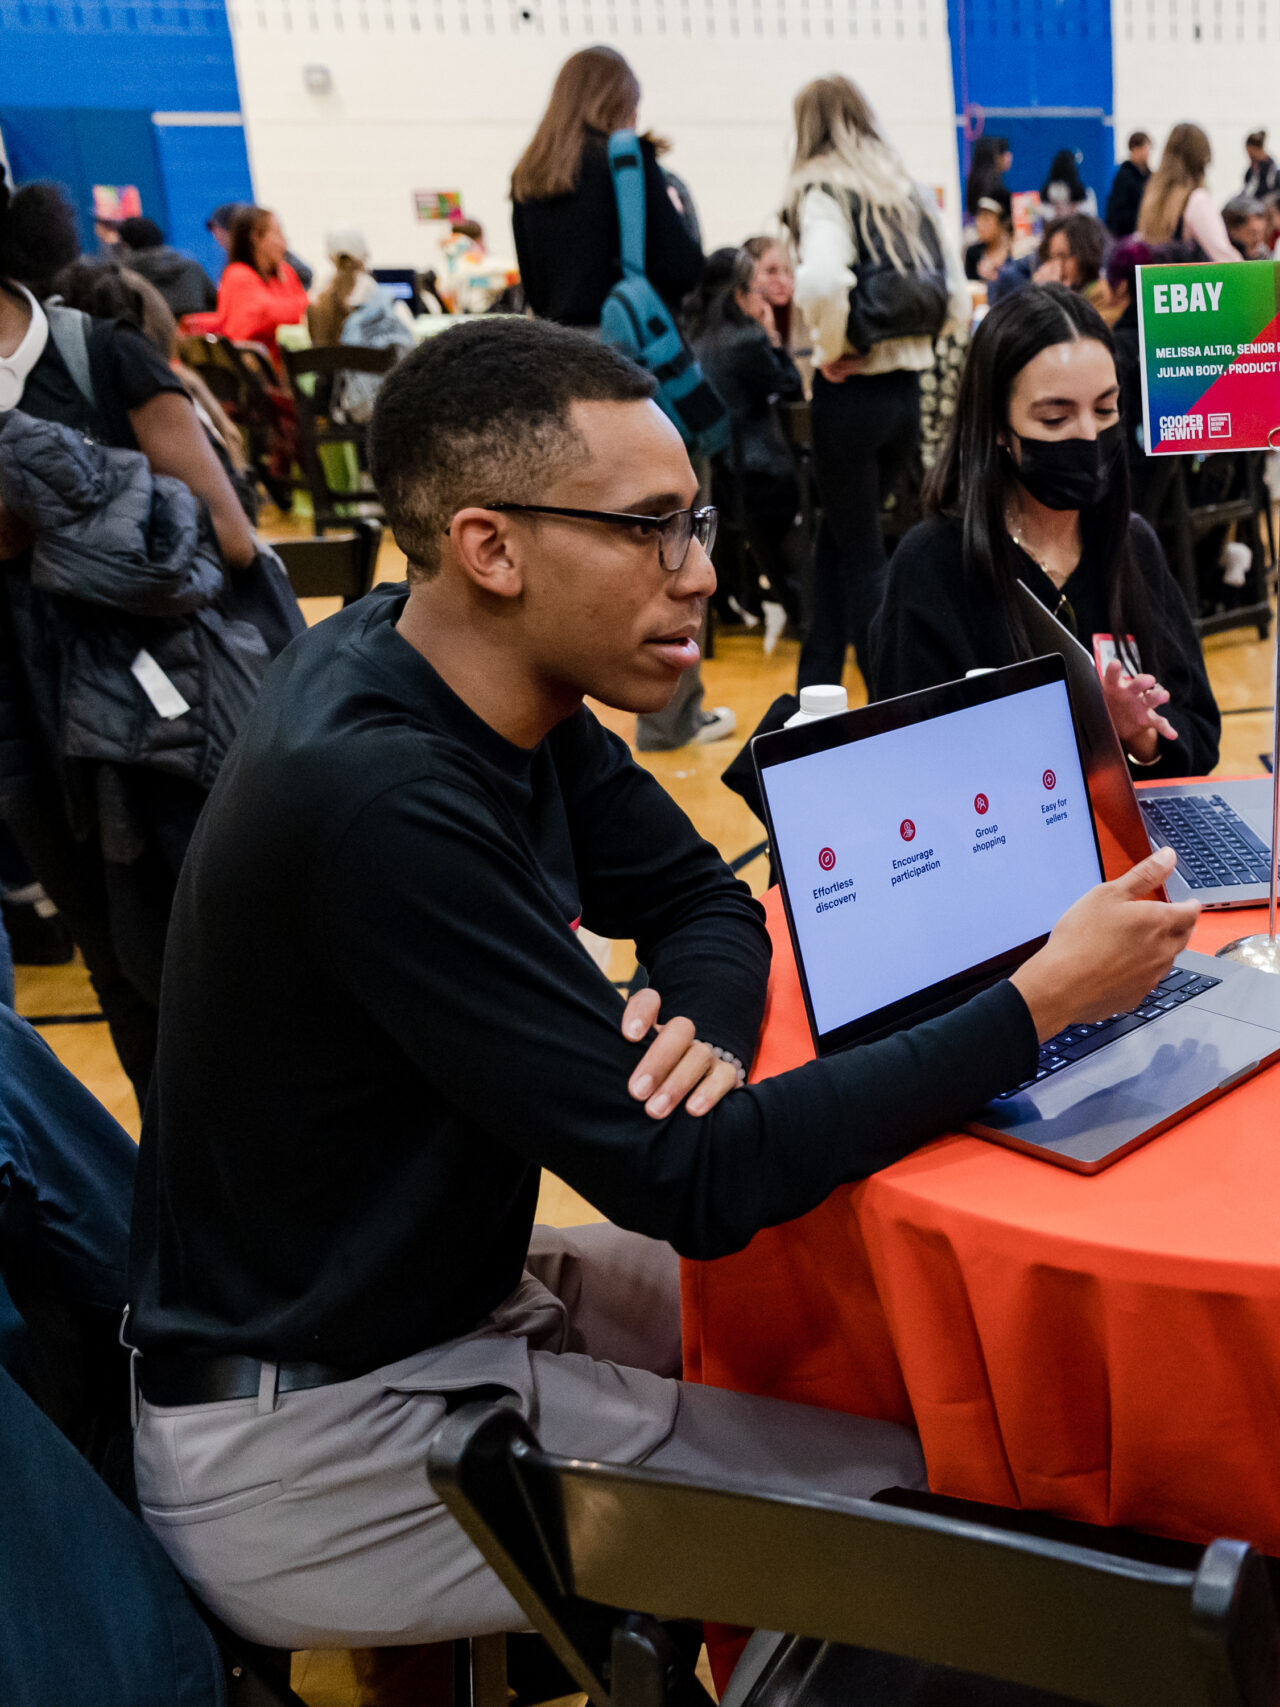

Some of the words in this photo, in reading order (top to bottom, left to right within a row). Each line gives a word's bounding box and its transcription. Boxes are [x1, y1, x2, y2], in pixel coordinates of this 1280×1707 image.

[1153, 281, 1224, 314] EBAY
[1155, 345, 1202, 359] MELISSA
[1203, 344, 1235, 356] ALTIG,
[1236, 342, 1275, 355] SENIOR
[1157, 366, 1194, 378] JULIAN
[1195, 364, 1227, 377] BODY,
[1228, 360, 1277, 375] PRODUCT
[1159, 414, 1204, 429] COOPER
[1160, 426, 1204, 441] HEWITT
[1041, 801, 1057, 814] Easy
[1056, 798, 1068, 809] for
[1045, 811, 1068, 826] sellers
[975, 824, 999, 838] Group
[972, 835, 1006, 854] shopping
[892, 848, 934, 870] Encourage
[890, 859, 941, 887] participation
[812, 878, 854, 900] Effortless
[815, 892, 857, 914] discovery
